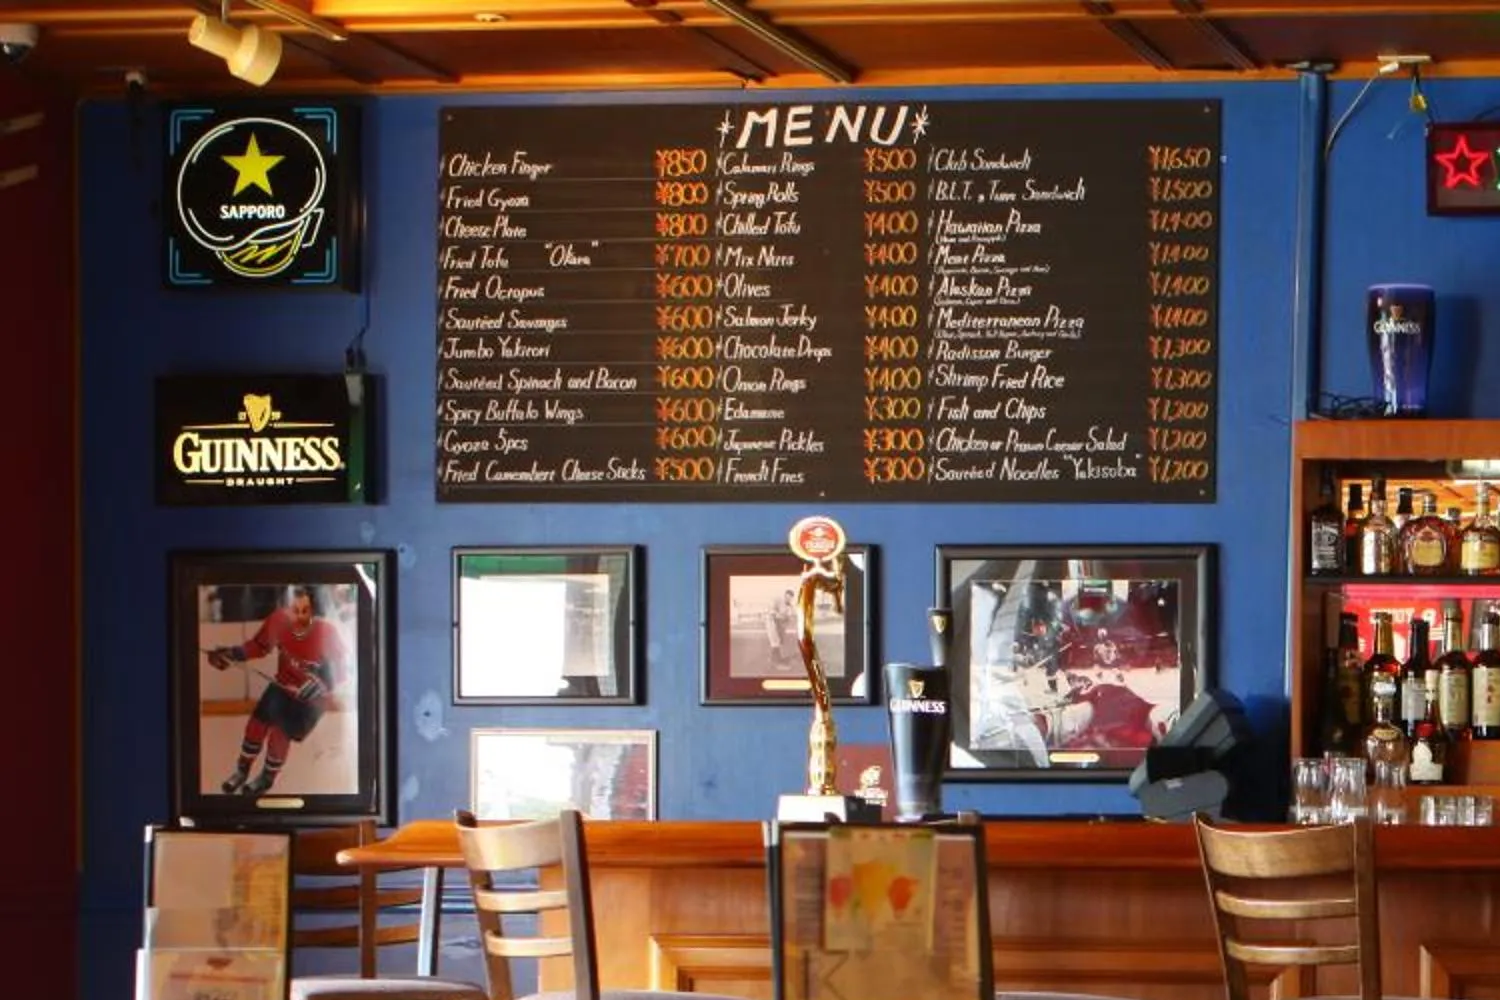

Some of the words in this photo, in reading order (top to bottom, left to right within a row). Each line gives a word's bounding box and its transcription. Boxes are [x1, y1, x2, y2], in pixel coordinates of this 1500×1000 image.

[735, 105, 908, 149] MENU
[450, 152, 507, 177] Chicken
[512, 151, 552, 180] Finger
[656, 149, 707, 178] ¥850
[780, 152, 815, 177] Rings
[864, 148, 917, 172] ¥500
[934, 148, 967, 170] Club
[970, 148, 1031, 170] Sandwich
[446, 185, 484, 208] Fried
[656, 181, 709, 206] ¥800
[723, 181, 765, 209] Spring
[767, 181, 799, 201] Rolls
[864, 179, 916, 203] ¥500
[1022, 177, 1086, 201] Sandwich
[219, 204, 285, 220] SAPPORO
[445, 216, 492, 238] Cheese
[493, 215, 527, 238] Plate
[656, 212, 707, 237] ¥800
[723, 212, 770, 235] Chilled
[773, 212, 800, 234] Tofu
[864, 210, 918, 236] ¥400
[937, 209, 1002, 234] Hawaiian
[1006, 208, 1040, 232] Pizza
[443, 246, 476, 269] Fried
[481, 246, 508, 268] Tofu
[656, 244, 710, 267] ¥700
[724, 246, 753, 266] Mix
[757, 245, 795, 267] Nuts
[864, 241, 917, 265] ¥400
[972, 244, 1006, 264] Pizza
[445, 276, 480, 299] Fried
[486, 275, 545, 301] Octopus
[657, 274, 713, 298] ¥600
[724, 272, 771, 298] Olives
[864, 275, 918, 298] ¥400
[937, 276, 992, 297] Alaskan
[996, 276, 1032, 297] Pizza
[657, 305, 713, 331] ¥600
[724, 305, 774, 327] Salmon
[776, 304, 817, 331] Jerky
[864, 305, 917, 328] ¥400
[937, 307, 1040, 328] Mediterranean
[1044, 304, 1085, 328] Pizza
[444, 337, 494, 359] Jumbo
[498, 335, 550, 358] Yakitori
[657, 335, 713, 360] ¥600
[724, 334, 796, 359] Chocolate
[798, 334, 832, 362] Drops
[864, 336, 918, 360] ¥400
[936, 340, 1000, 360] Radisson
[1005, 339, 1052, 362] Burger
[508, 368, 561, 394] Spinach
[568, 370, 594, 389] and
[596, 368, 637, 389] Bacon
[657, 366, 714, 389] ¥600
[723, 365, 766, 392] Onion
[770, 367, 807, 393] Rings
[864, 365, 921, 391] ¥400
[935, 364, 988, 391] Shrimp
[992, 363, 1026, 389] Fried
[1031, 364, 1065, 389] Rice
[444, 399, 481, 425] Spicy
[485, 400, 538, 421] Buffalo
[545, 400, 584, 424] Wings
[657, 397, 715, 422] ¥600
[864, 396, 920, 421] ¥300
[937, 396, 967, 420] Fish
[973, 402, 1000, 419] and
[1005, 397, 1046, 424] Chips
[495, 428, 528, 454] 5pcs
[657, 425, 716, 449] ¥600
[779, 427, 824, 452] Pickles
[864, 428, 924, 451] ¥300
[935, 428, 988, 452] Chicken
[1086, 426, 1127, 451] Salad
[173, 432, 341, 473] GUINNESS
[443, 460, 480, 482] Fried
[561, 459, 603, 481] Cheese
[606, 457, 646, 480] Sticks
[655, 456, 714, 481] ¥500
[725, 458, 768, 483] French
[771, 457, 804, 483] Fries
[864, 457, 925, 483] ¥300
[1000, 457, 1059, 481] Noodles
[226, 477, 294, 488] DRAUGHT
